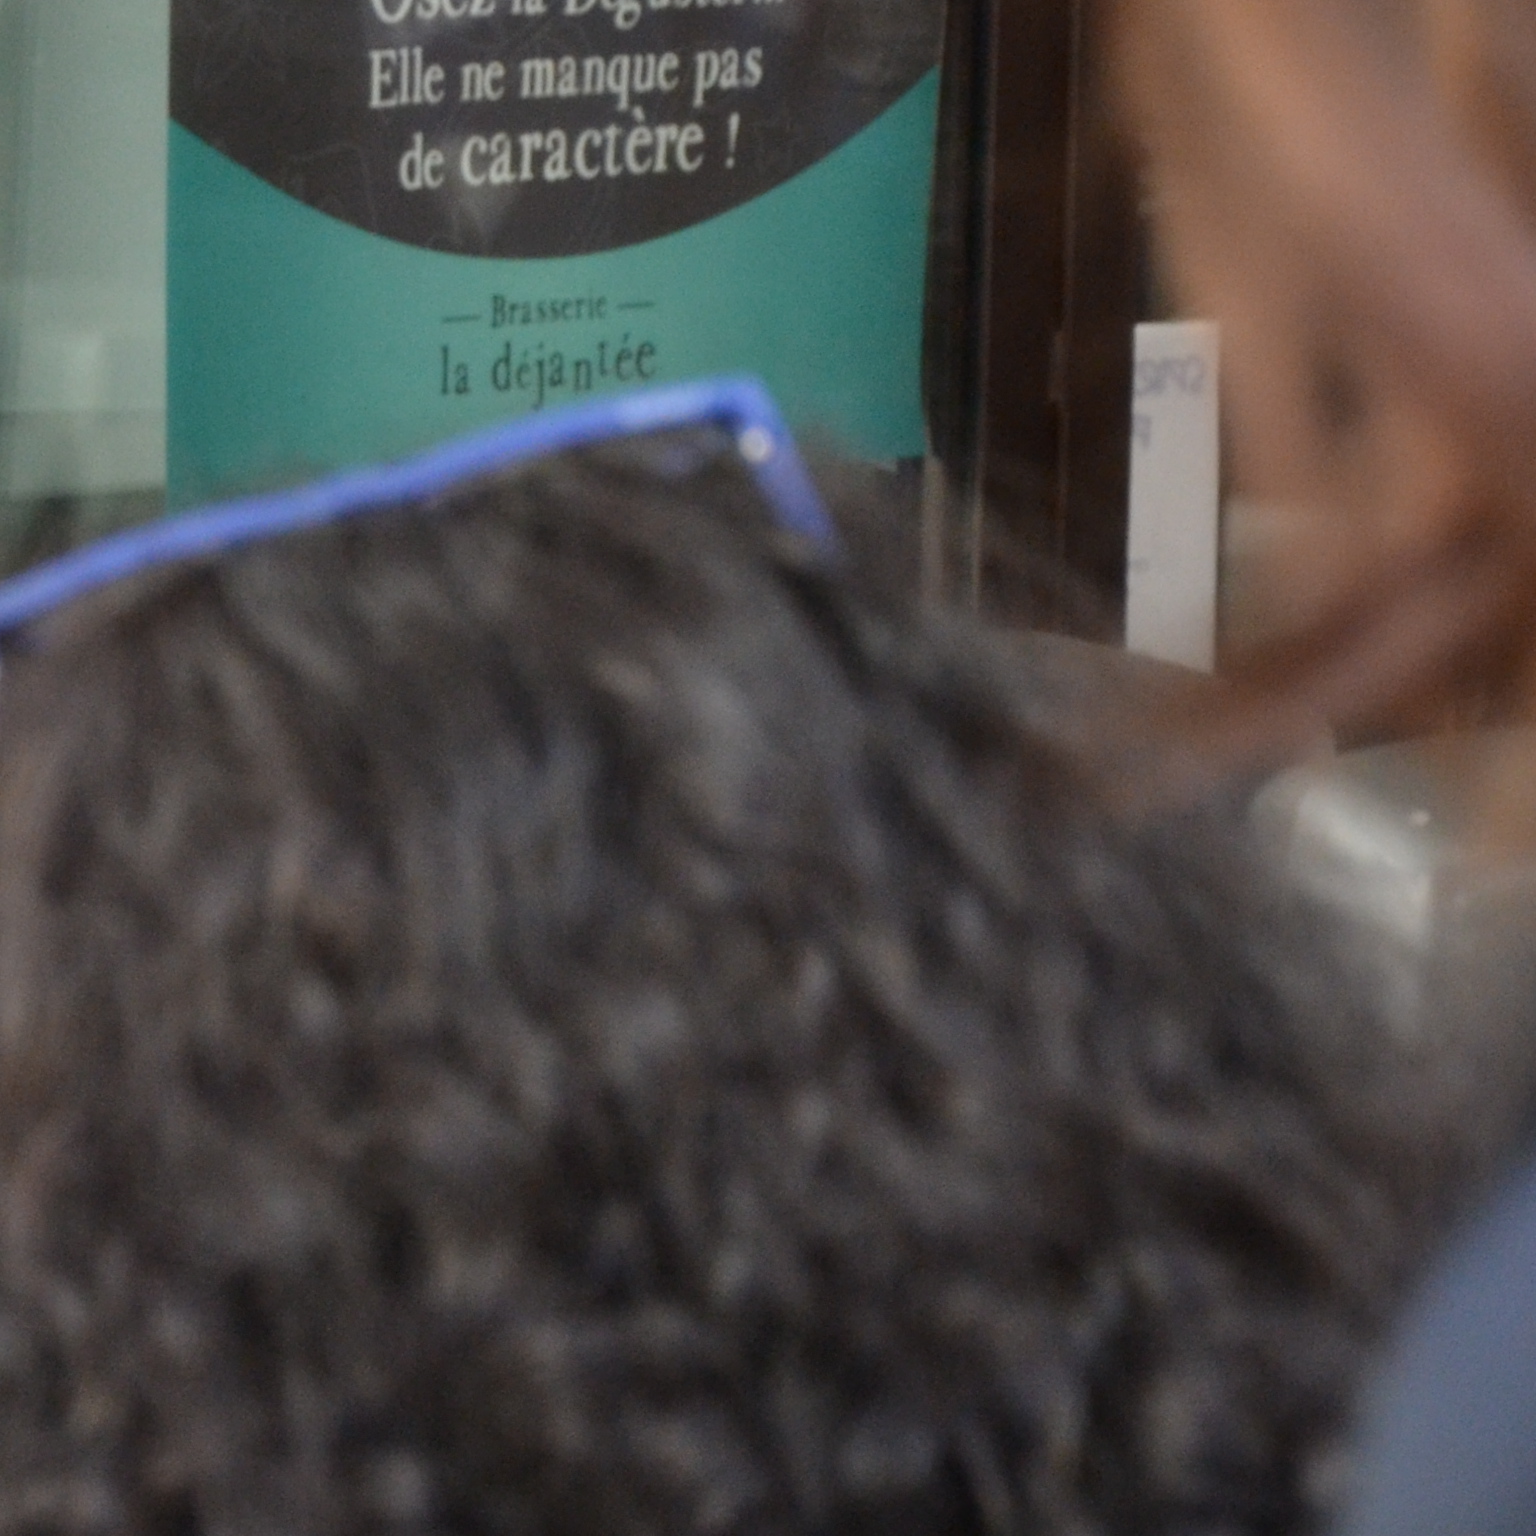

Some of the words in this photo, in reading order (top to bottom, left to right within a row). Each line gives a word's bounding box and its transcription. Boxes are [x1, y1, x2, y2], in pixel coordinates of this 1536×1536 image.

[369, 49, 446, 109] Elle
[460, 62, 506, 103] ne
[520, 47, 680, 109] manque
[693, 45, 763, 105] pas
[399, 132, 445, 191] de
[460, 108, 705, 187] caractère
[725, 112, 741, 168] !
[490, 293, 607, 329] Brasserie
[441, 344, 470, 395] la
[491, 332, 656, 412] déjantée
